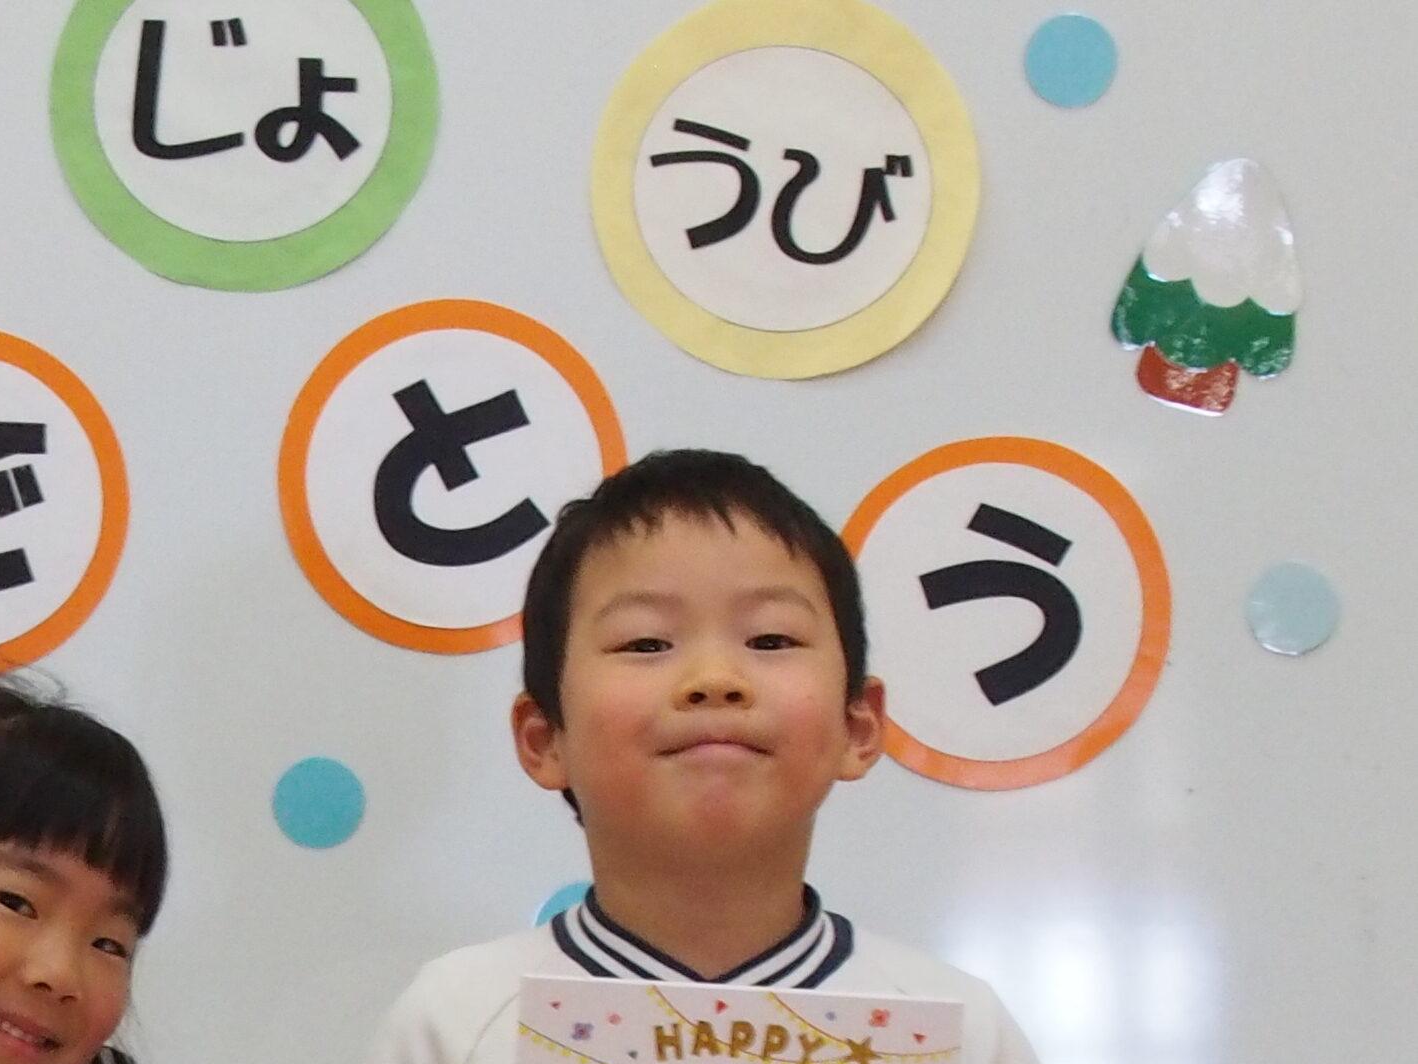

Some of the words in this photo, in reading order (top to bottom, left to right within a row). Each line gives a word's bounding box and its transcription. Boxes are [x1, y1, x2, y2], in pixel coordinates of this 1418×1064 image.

[132, 18, 360, 163] じょ
[650, 118, 912, 265] うび
[373, 379, 550, 567] と
[919, 503, 1082, 706] う
